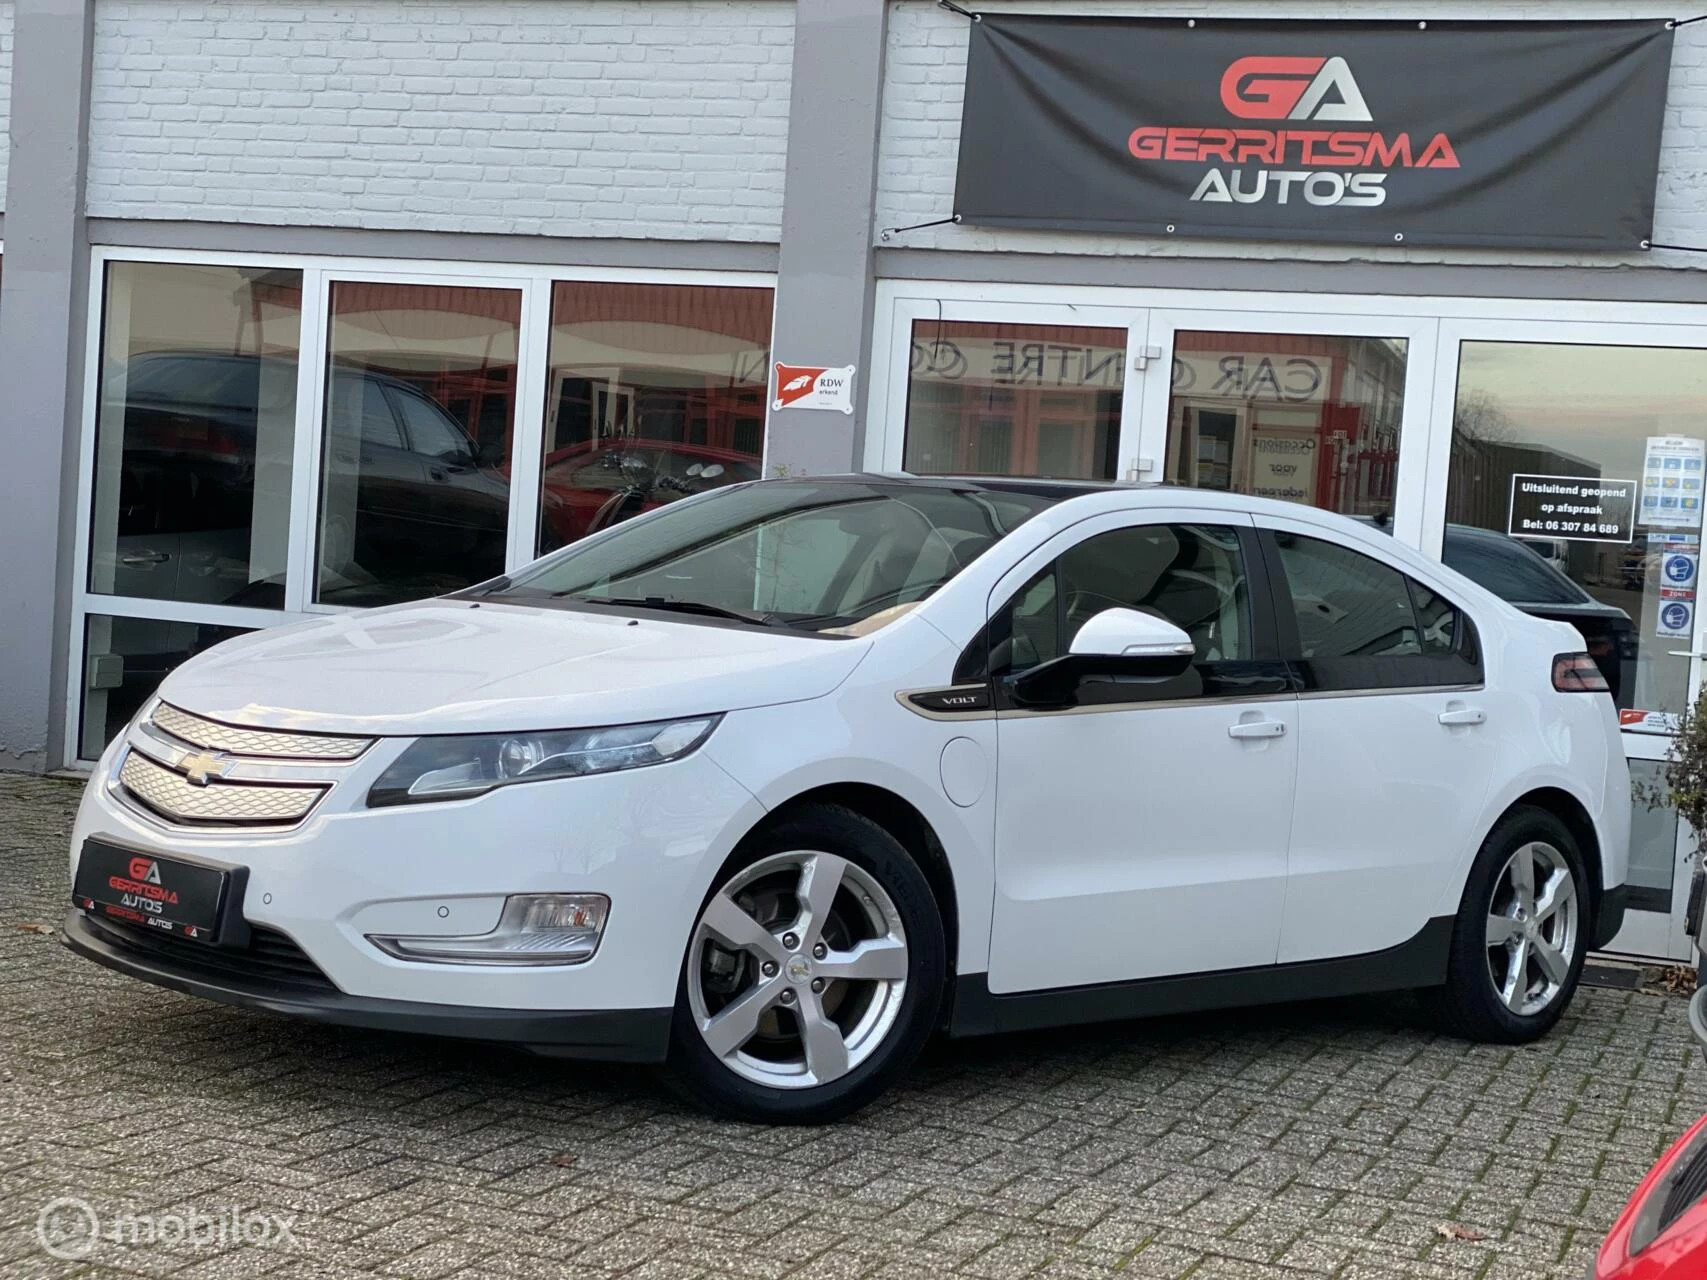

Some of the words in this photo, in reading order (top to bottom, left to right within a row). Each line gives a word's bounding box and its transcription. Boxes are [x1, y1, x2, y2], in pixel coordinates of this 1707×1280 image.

[1220, 56, 1374, 122] GA
[1128, 126, 1461, 168] GERRITSMA
[1189, 167, 1387, 207] AUTO'S
[820, 378, 844, 388] RDW
[1522, 482, 1579, 495] Uitsluitend
[1581, 488, 1626, 499] geopend
[1541, 504, 1554, 513] op
[1556, 503, 1603, 515] afspraak
[1522, 519, 1543, 530] Bel:
[1545, 521, 1559, 530] 06
[1561, 522, 1581, 532] 307
[1583, 523, 1597, 533] 84
[1599, 524, 1619, 534] 689
[942, 696, 977, 705] VOLT
[129, 857, 161, 884] GA
[109, 876, 178, 904] GERRITSMA
